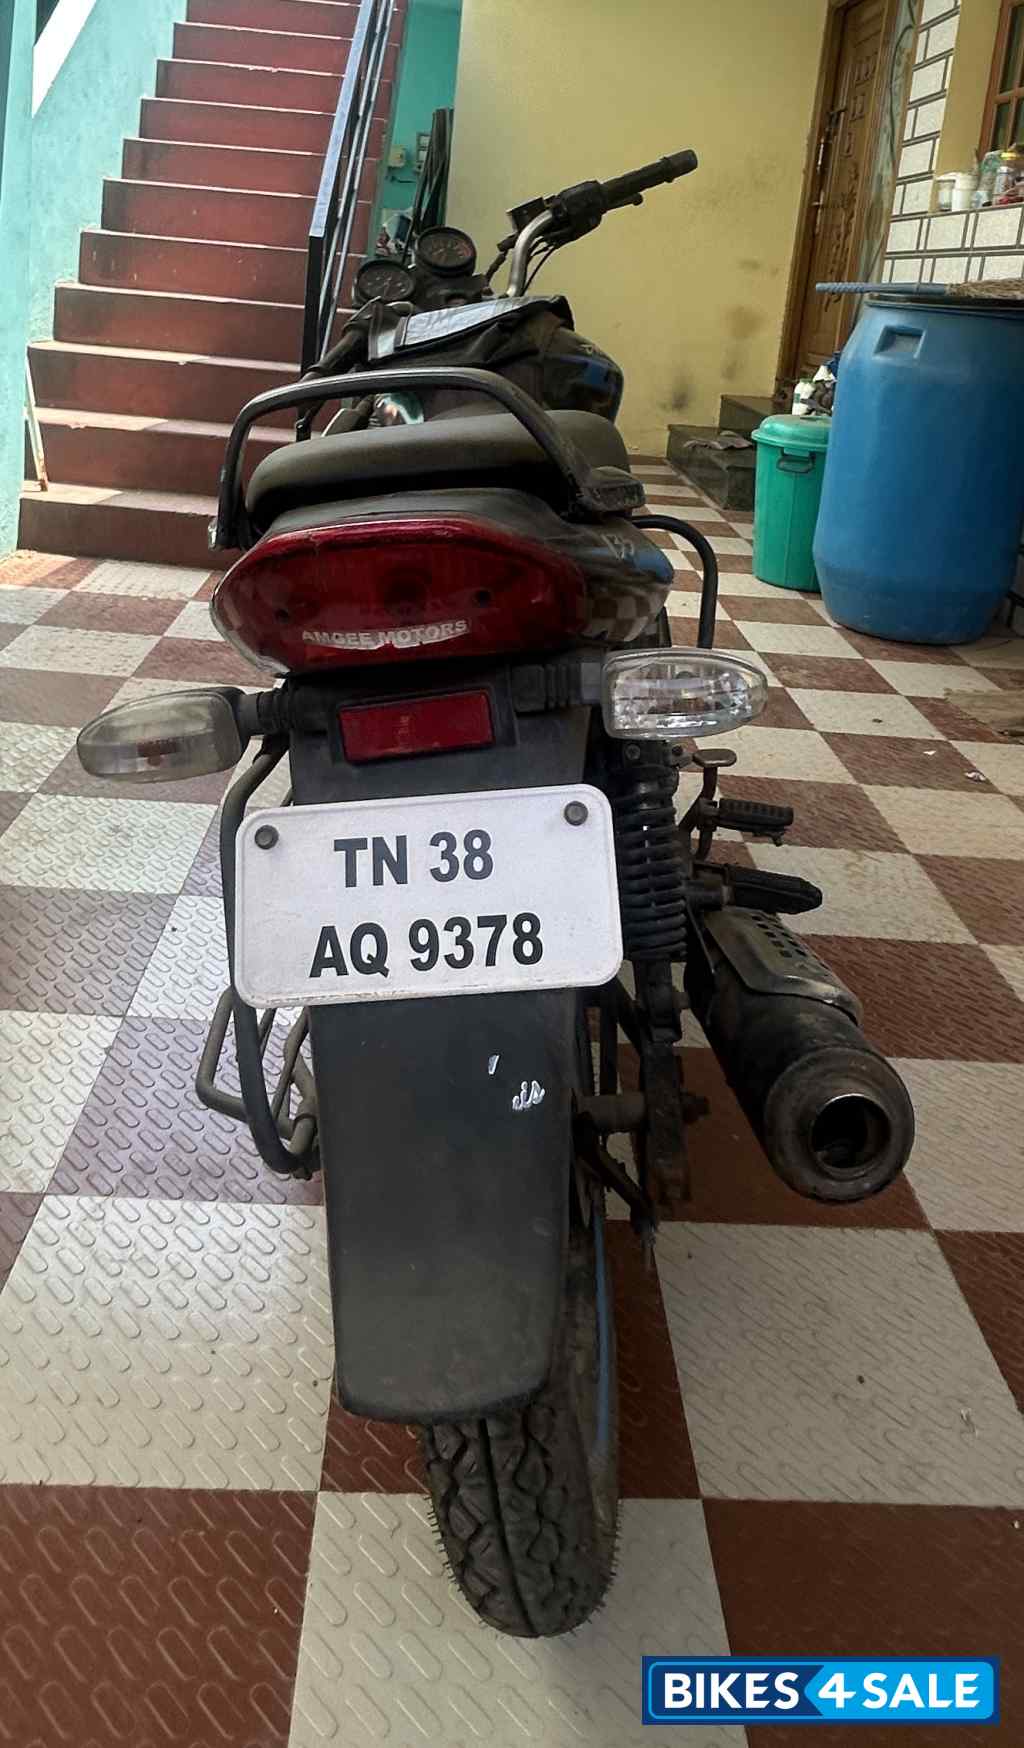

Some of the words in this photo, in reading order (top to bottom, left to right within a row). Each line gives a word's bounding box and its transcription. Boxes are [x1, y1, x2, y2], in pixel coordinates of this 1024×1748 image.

[377, 619, 467, 644] MOTORS
[333, 834, 408, 888] TN
[429, 829, 494, 882] 38
[309, 922, 390, 978] AQ
[408, 912, 543, 971] 9378
